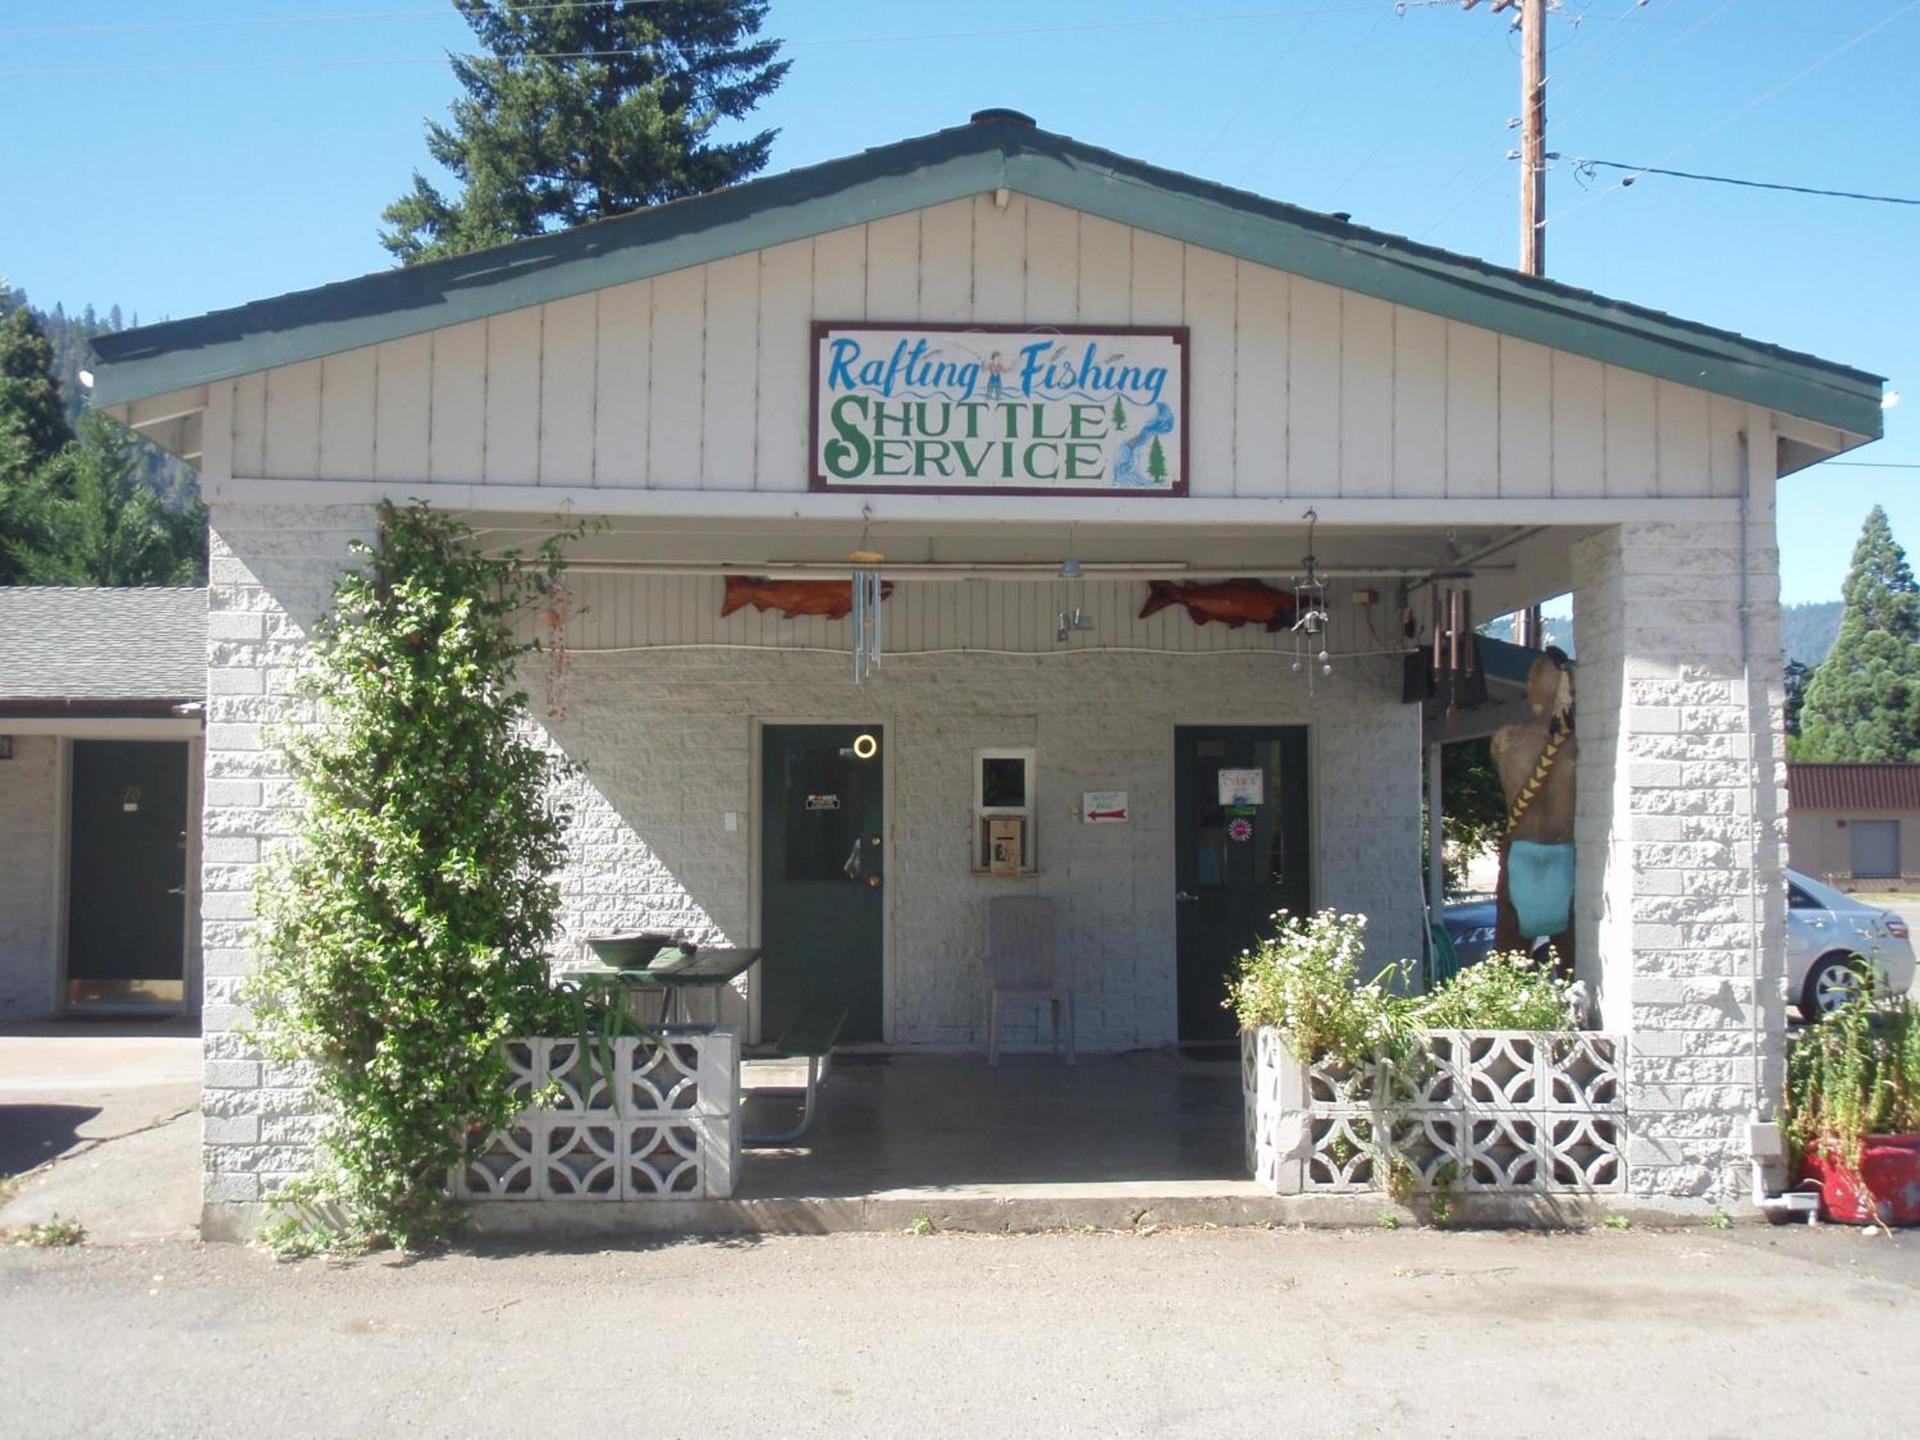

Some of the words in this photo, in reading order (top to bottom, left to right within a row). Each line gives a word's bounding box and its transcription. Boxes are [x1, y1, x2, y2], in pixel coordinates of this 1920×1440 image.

[828, 337, 984, 401] Rafting
[1019, 339, 1168, 405] Fishing
[829, 394, 1109, 440] SHUTTLE
[824, 436, 1105, 479] SERVICE
